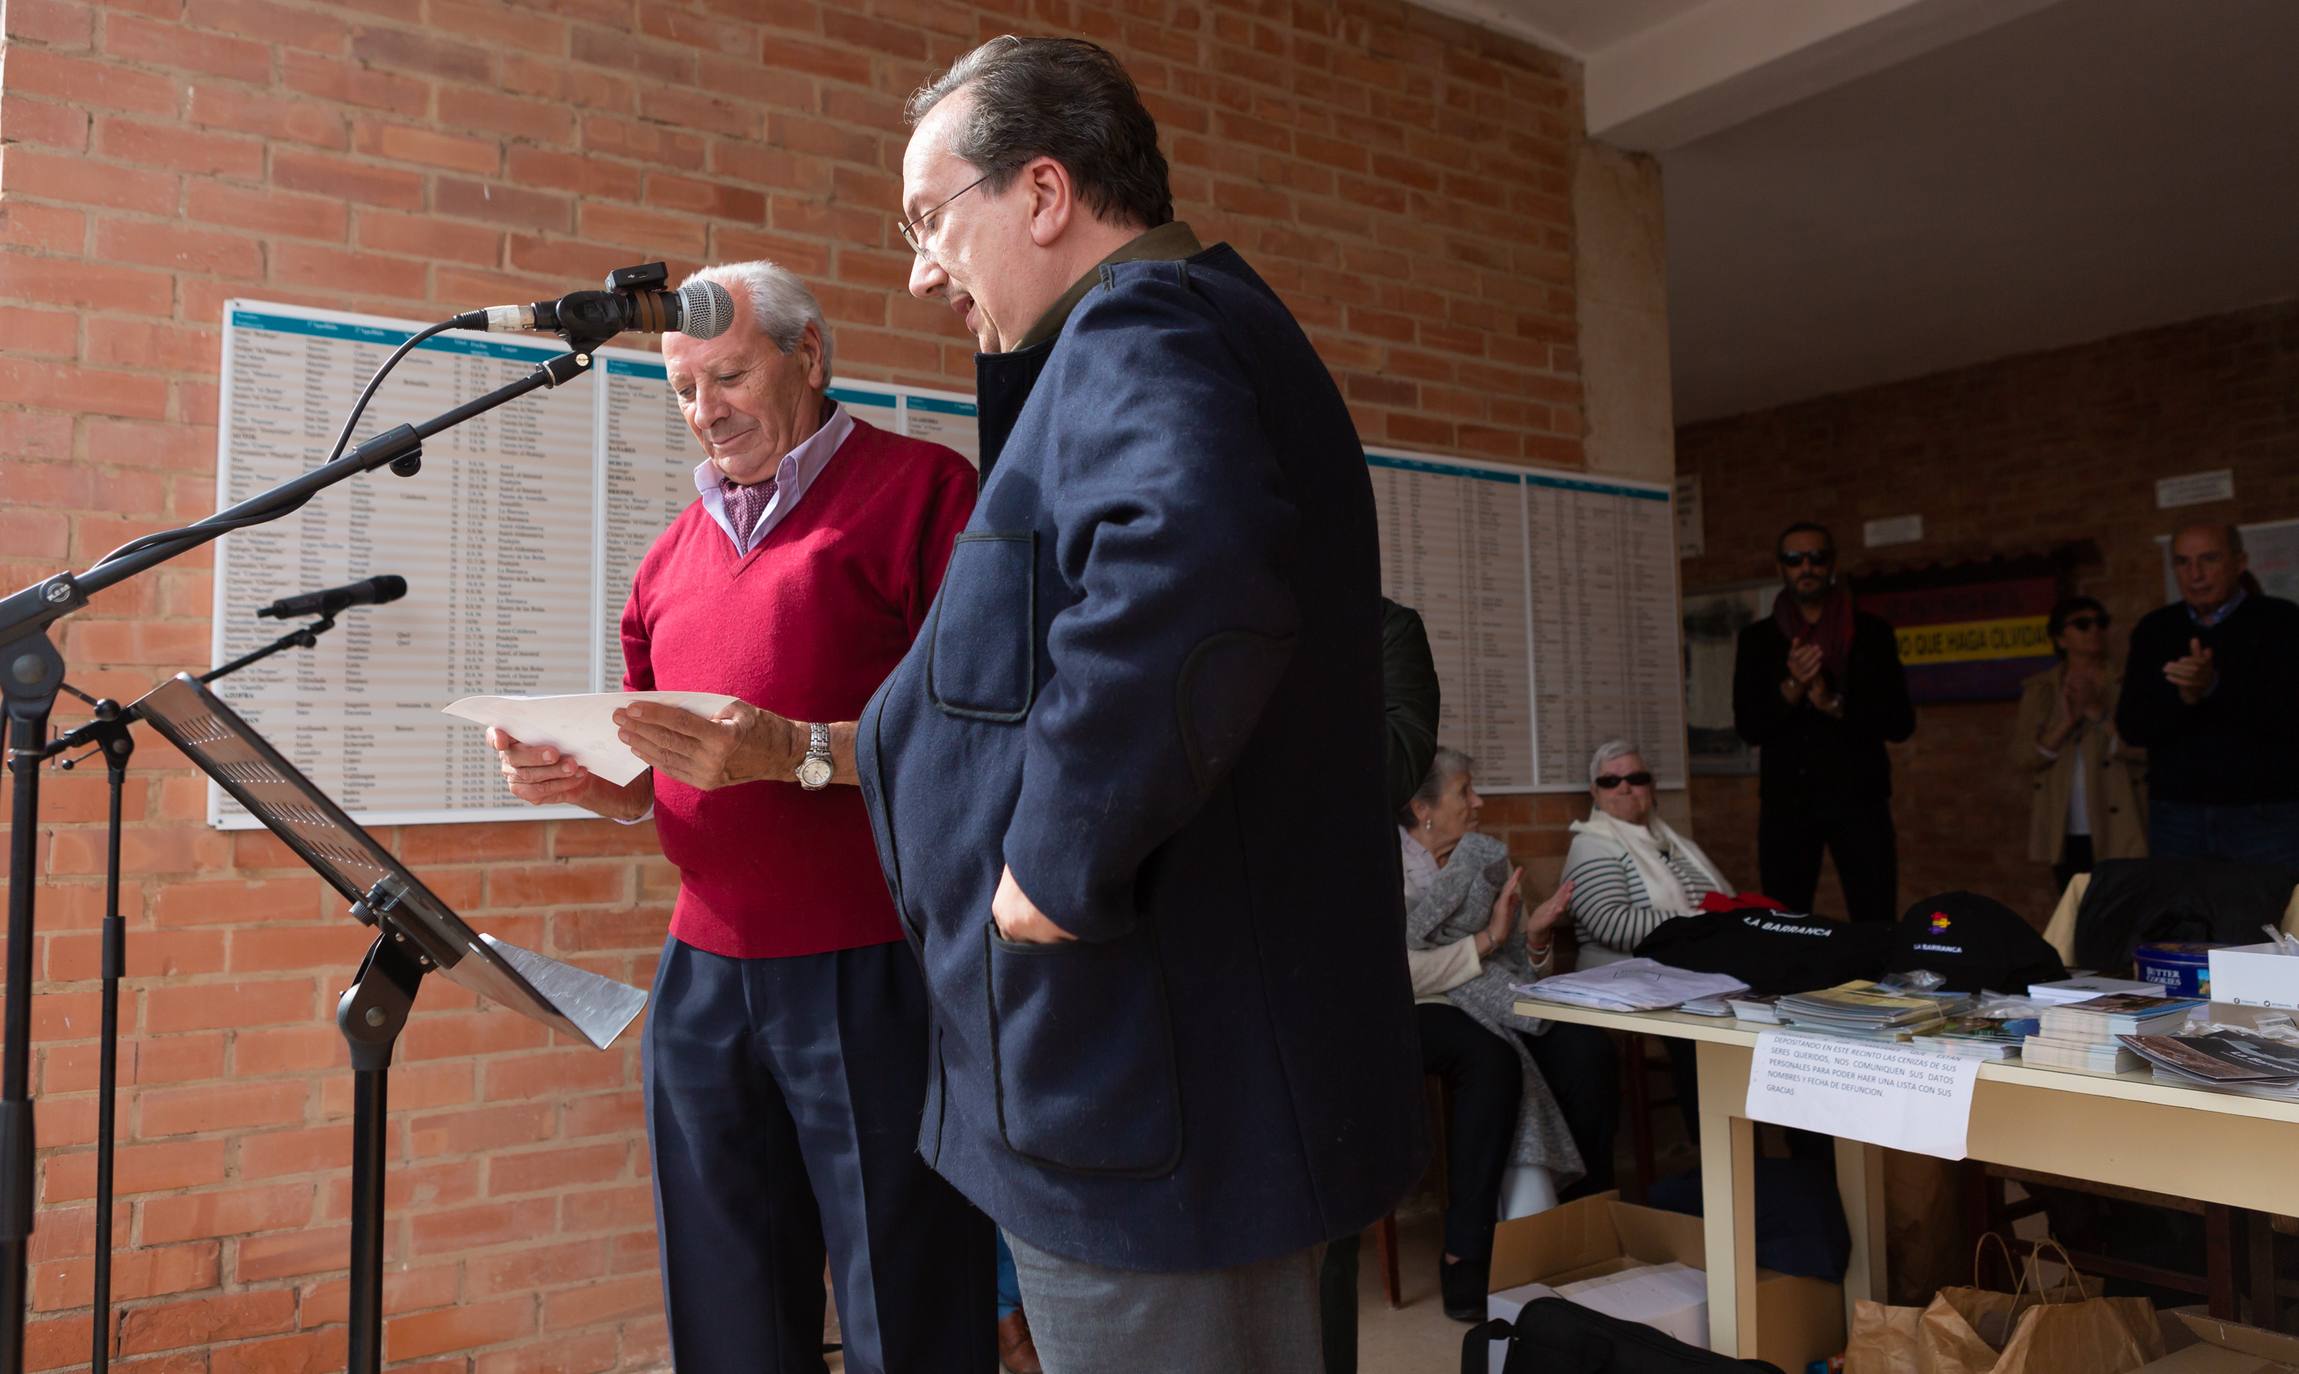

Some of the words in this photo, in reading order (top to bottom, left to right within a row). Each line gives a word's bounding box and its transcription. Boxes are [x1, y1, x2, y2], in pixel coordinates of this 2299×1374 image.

[1916, 631, 1944, 656] QUE
[1948, 627, 1987, 653] HAGA
[1743, 916, 1761, 927] LA
[1761, 921, 1833, 937] BARRANCA
[2146, 966, 2181, 979] BUTTER
[2146, 975, 2182, 987] COOKIES
[1771, 1046, 1790, 1057] SERES
[1834, 1056, 1850, 1067] NOS
[1852, 1060, 1905, 1076] COMUNIQUEN
[1909, 1069, 1924, 1080] SUS
[1927, 1072, 1955, 1085] DATOS
[1773, 1035, 1822, 1050] DEPOSITANDO
[1822, 1042, 1832, 1051] EN
[1833, 1044, 1850, 1054] ESTE
[1851, 1047, 1882, 1059] RECINTO
[1882, 1053, 1897, 1062] LAS
[1897, 1055, 1929, 1067] CENIZAS
[1929, 1060, 1940, 1070] DE
[1940, 1062, 1957, 1073] SUS
[1767, 1070, 1802, 1083] NOMBRES
[1807, 1076, 1829, 1087] FECHA
[1830, 1080, 1840, 1089] DE
[1769, 1058, 1811, 1072] PERSONALES
[1811, 1065, 1831, 1075] PARA
[1831, 1068, 1856, 1080] PODER
[1877, 1077, 1895, 1088] UNA
[1896, 1079, 1918, 1091] LISTA
[1917, 1083, 1936, 1095] CON
[1936, 1086, 1953, 1098] SUS
